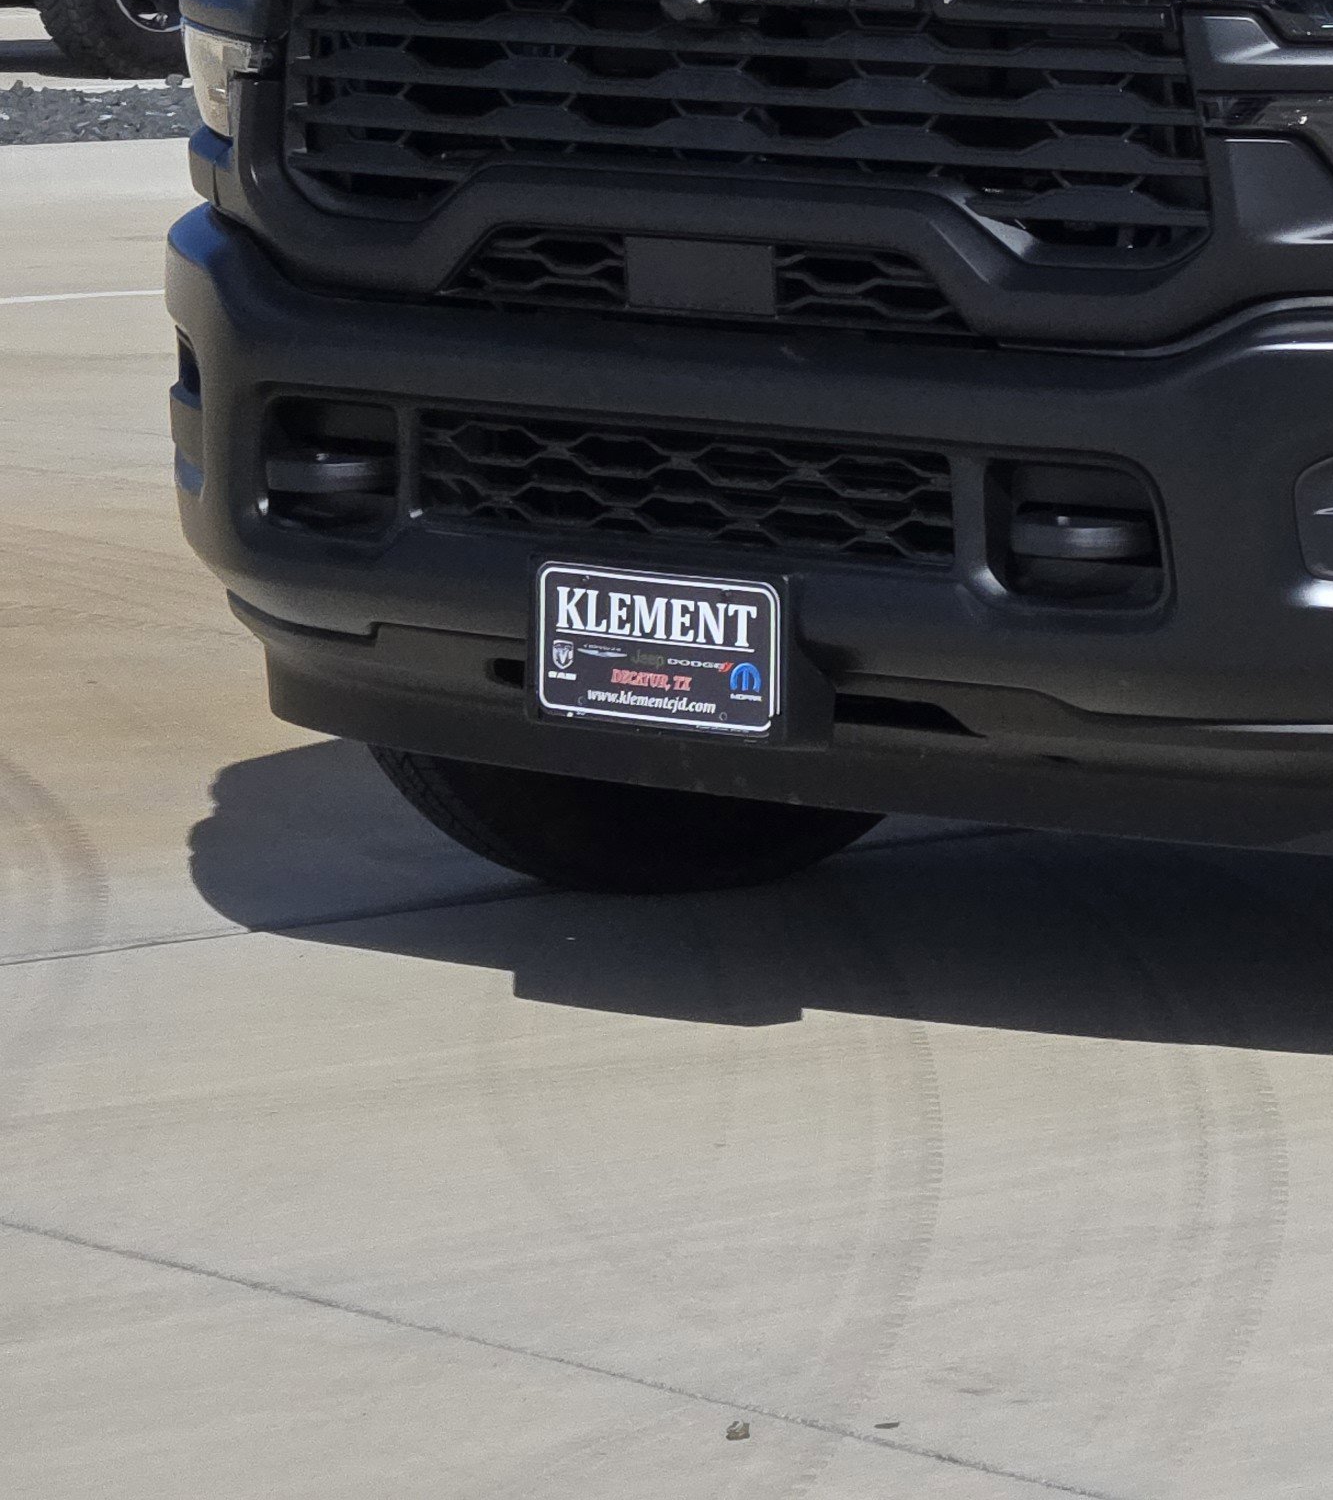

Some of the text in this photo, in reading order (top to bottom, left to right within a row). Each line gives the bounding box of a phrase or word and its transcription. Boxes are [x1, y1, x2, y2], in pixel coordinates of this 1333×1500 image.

[555, 585, 758, 648] KLEMENT
[673, 675, 693, 692] TX
[587, 689, 717, 714] www.klementcjd.com
